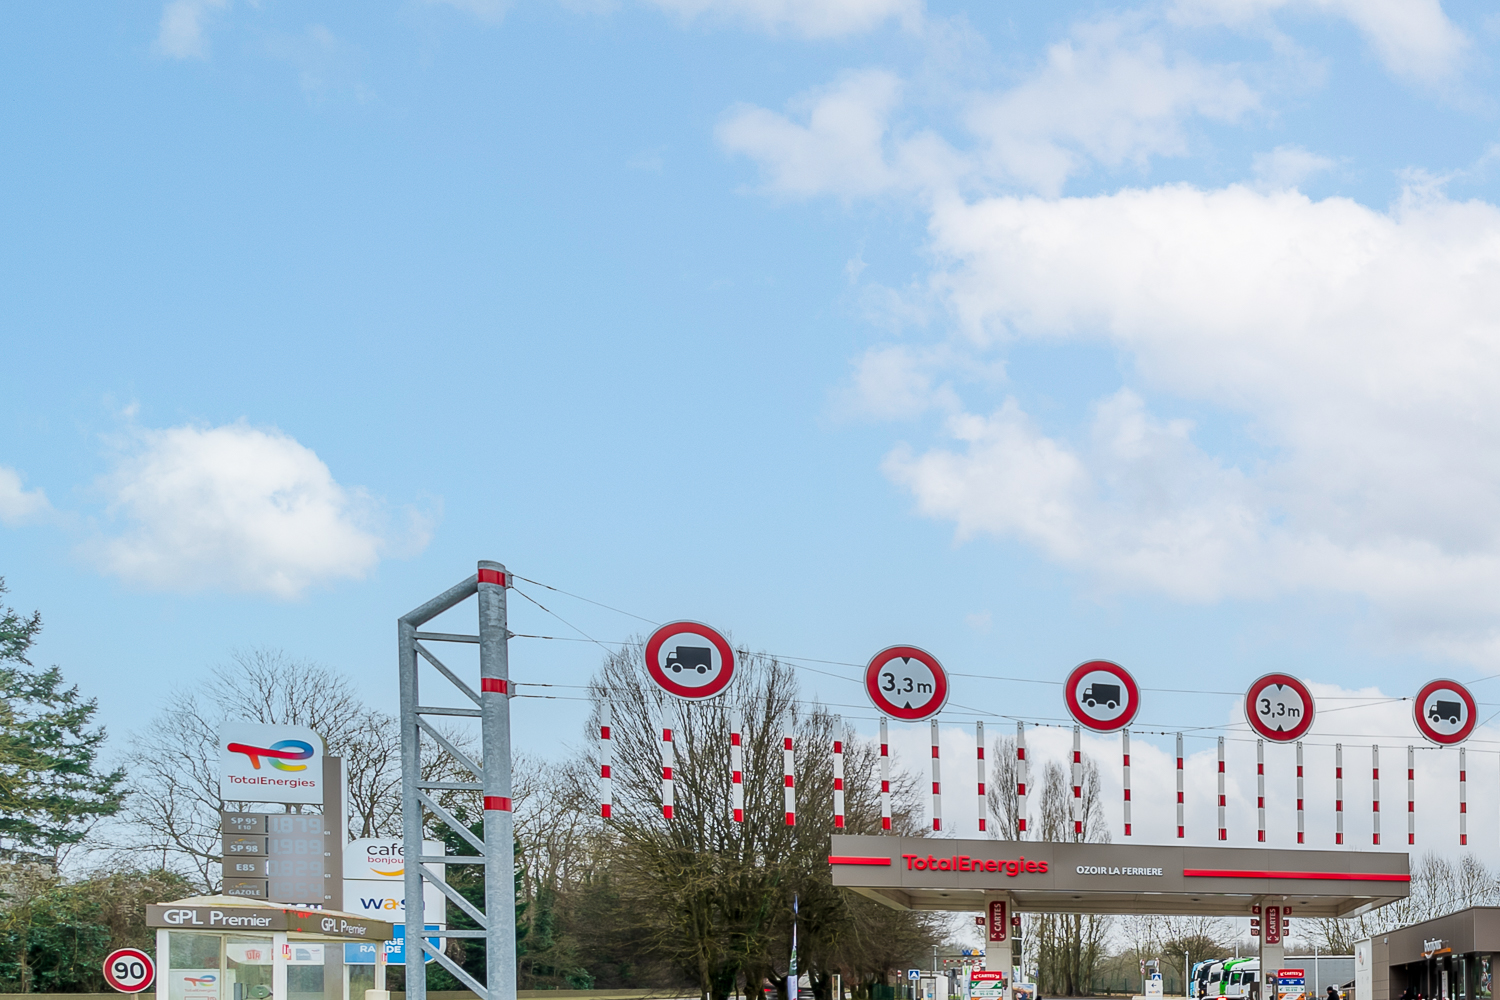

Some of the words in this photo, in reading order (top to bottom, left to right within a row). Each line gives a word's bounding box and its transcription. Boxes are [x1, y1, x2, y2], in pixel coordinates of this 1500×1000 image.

[228, 775, 316, 788] TotalEnergies
[245, 817, 257, 825] 95
[236, 863, 255, 871] E85
[368, 856, 404, 865] bonjou
[902, 854, 1048, 877] TotalEnergies
[1076, 865, 1107, 875] OZOIR
[1108, 866, 1120, 875] LA
[1122, 866, 1163, 876] FERRIERE
[360, 897, 425, 910] wa
[163, 909, 204, 925] GPL
[210, 910, 272, 926] Premier
[321, 917, 339, 932] GPL
[341, 919, 367, 935] Premier
[114, 962, 145, 979] 90
